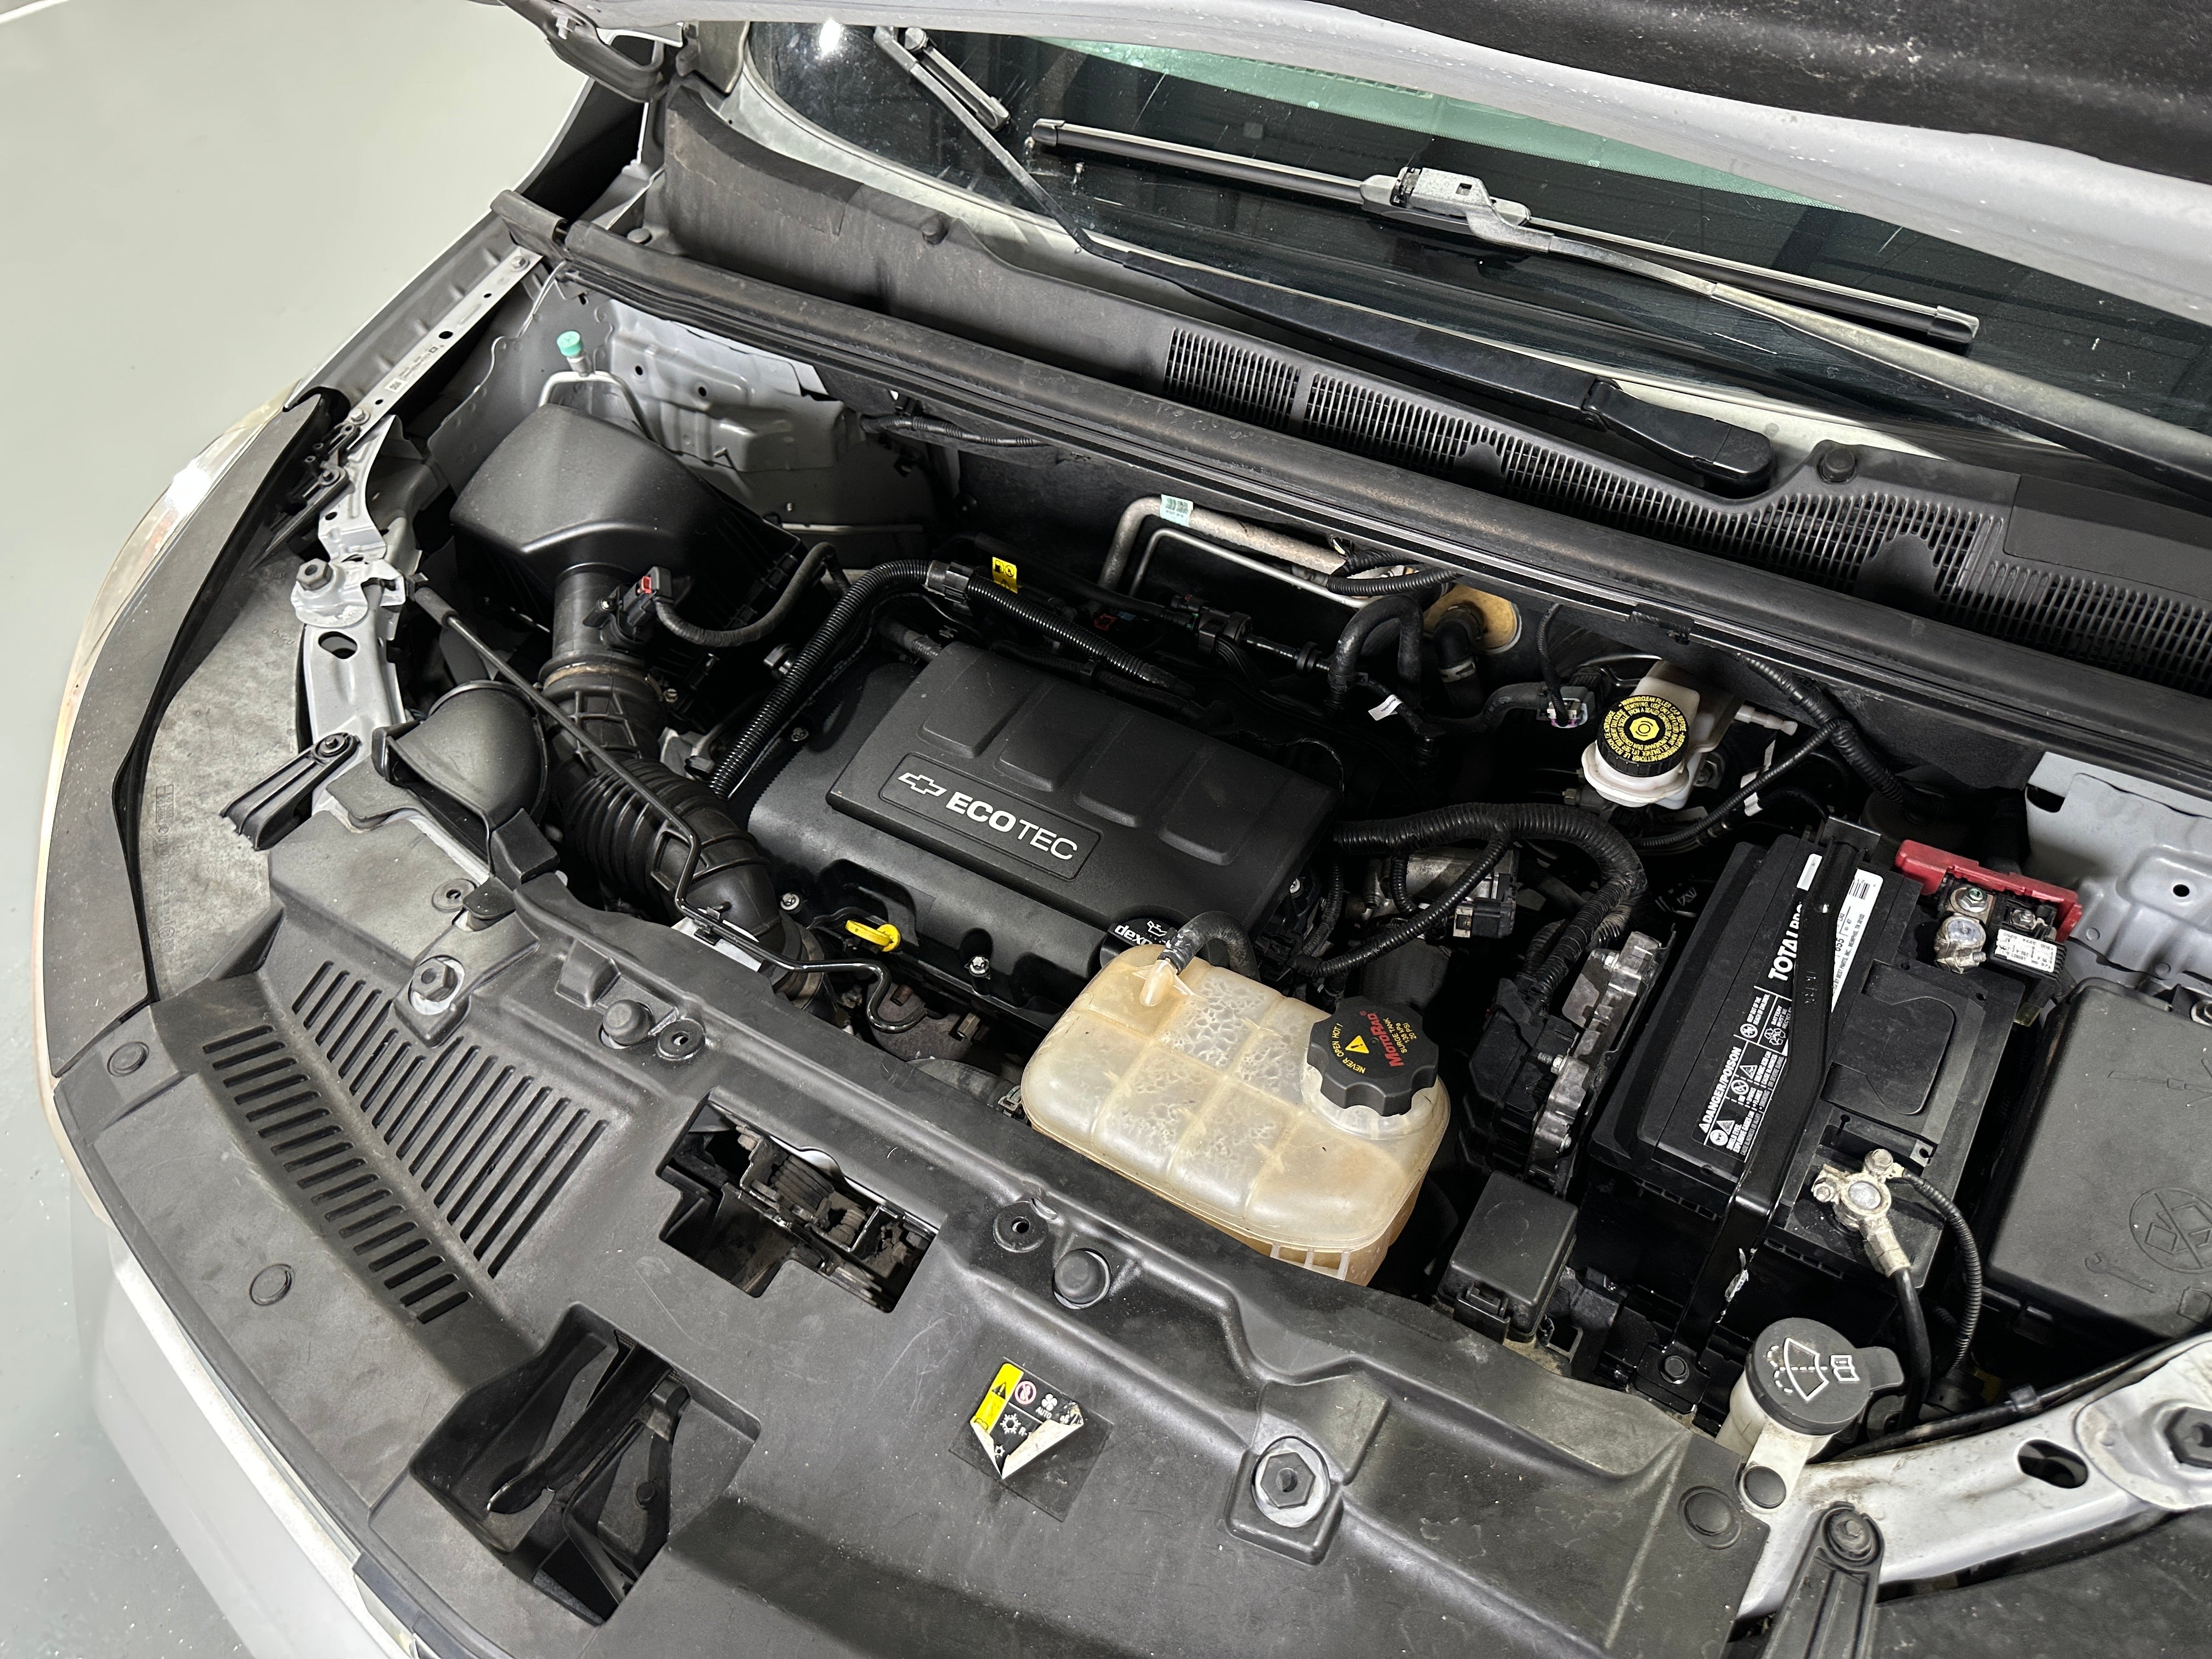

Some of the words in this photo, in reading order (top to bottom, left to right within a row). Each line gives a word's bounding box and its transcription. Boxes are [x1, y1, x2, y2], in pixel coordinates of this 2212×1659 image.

[1628, 708, 1640, 716] FROM
[1670, 707, 1680, 715] CAP
[945, 791, 1077, 860] ECOTEC
[1771, 1006, 1782, 1025] BATTERY
[1776, 1015, 1785, 1027] MUST
[1383, 1017, 1395, 1033] TANK
[1403, 1023, 1412, 1032] PSI
[1332, 1041, 1344, 1057] OPEN
[1392, 1033, 1407, 1053] SURGE
[1342, 1057, 1365, 1073] NEVER
[1702, 1047, 1741, 1124] DANGER/POISON
[1035, 1407, 1052, 1419] AUTO
